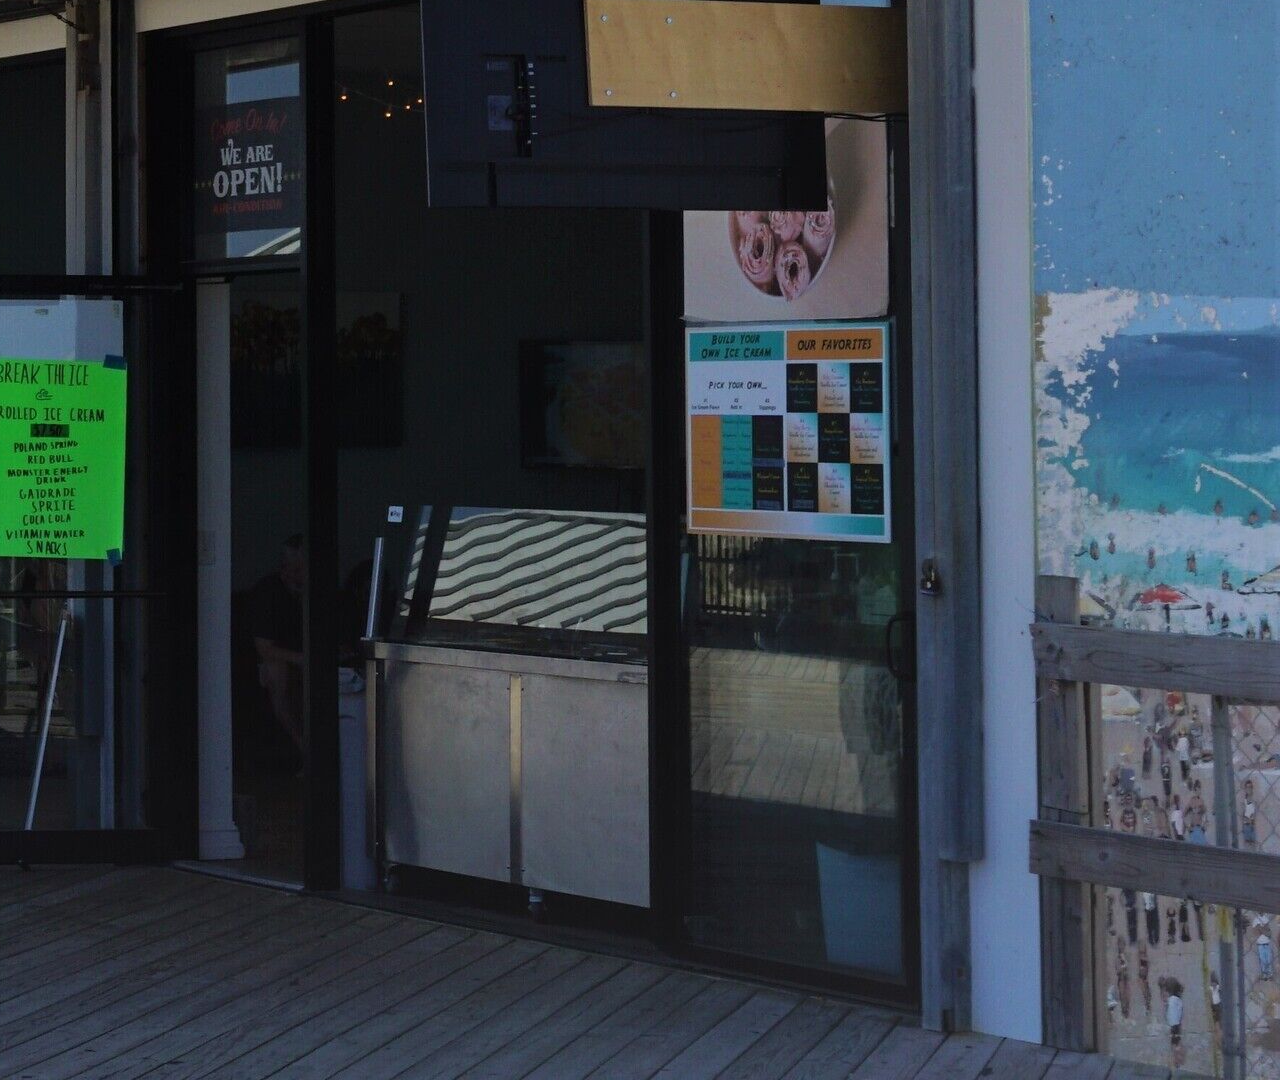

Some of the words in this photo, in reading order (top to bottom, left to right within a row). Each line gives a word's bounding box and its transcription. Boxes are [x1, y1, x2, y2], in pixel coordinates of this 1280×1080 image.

[221, 139, 242, 166] WE
[246, 144, 274, 164] ARE
[213, 162, 283, 198] OPEN!
[712, 335, 737, 345] BUILD
[741, 334, 761, 344] YOUR
[797, 339, 817, 351] OUR
[821, 338, 872, 350] FAVORITES
[744, 347, 772, 359] CREAM
[69, 364, 89, 386] ICE
[43, 408, 62, 421] ICE
[70, 408, 105, 422] CREAM
[14, 442, 47, 453] POLAND
[49, 454, 74, 463] BULL
[36, 476, 67, 485] DRINK
[19, 488, 76, 500] GATORADE
[31, 499, 76, 513] SPRITE
[6, 529, 50, 540] VITAMIN
[53, 529, 86, 539] WATER
